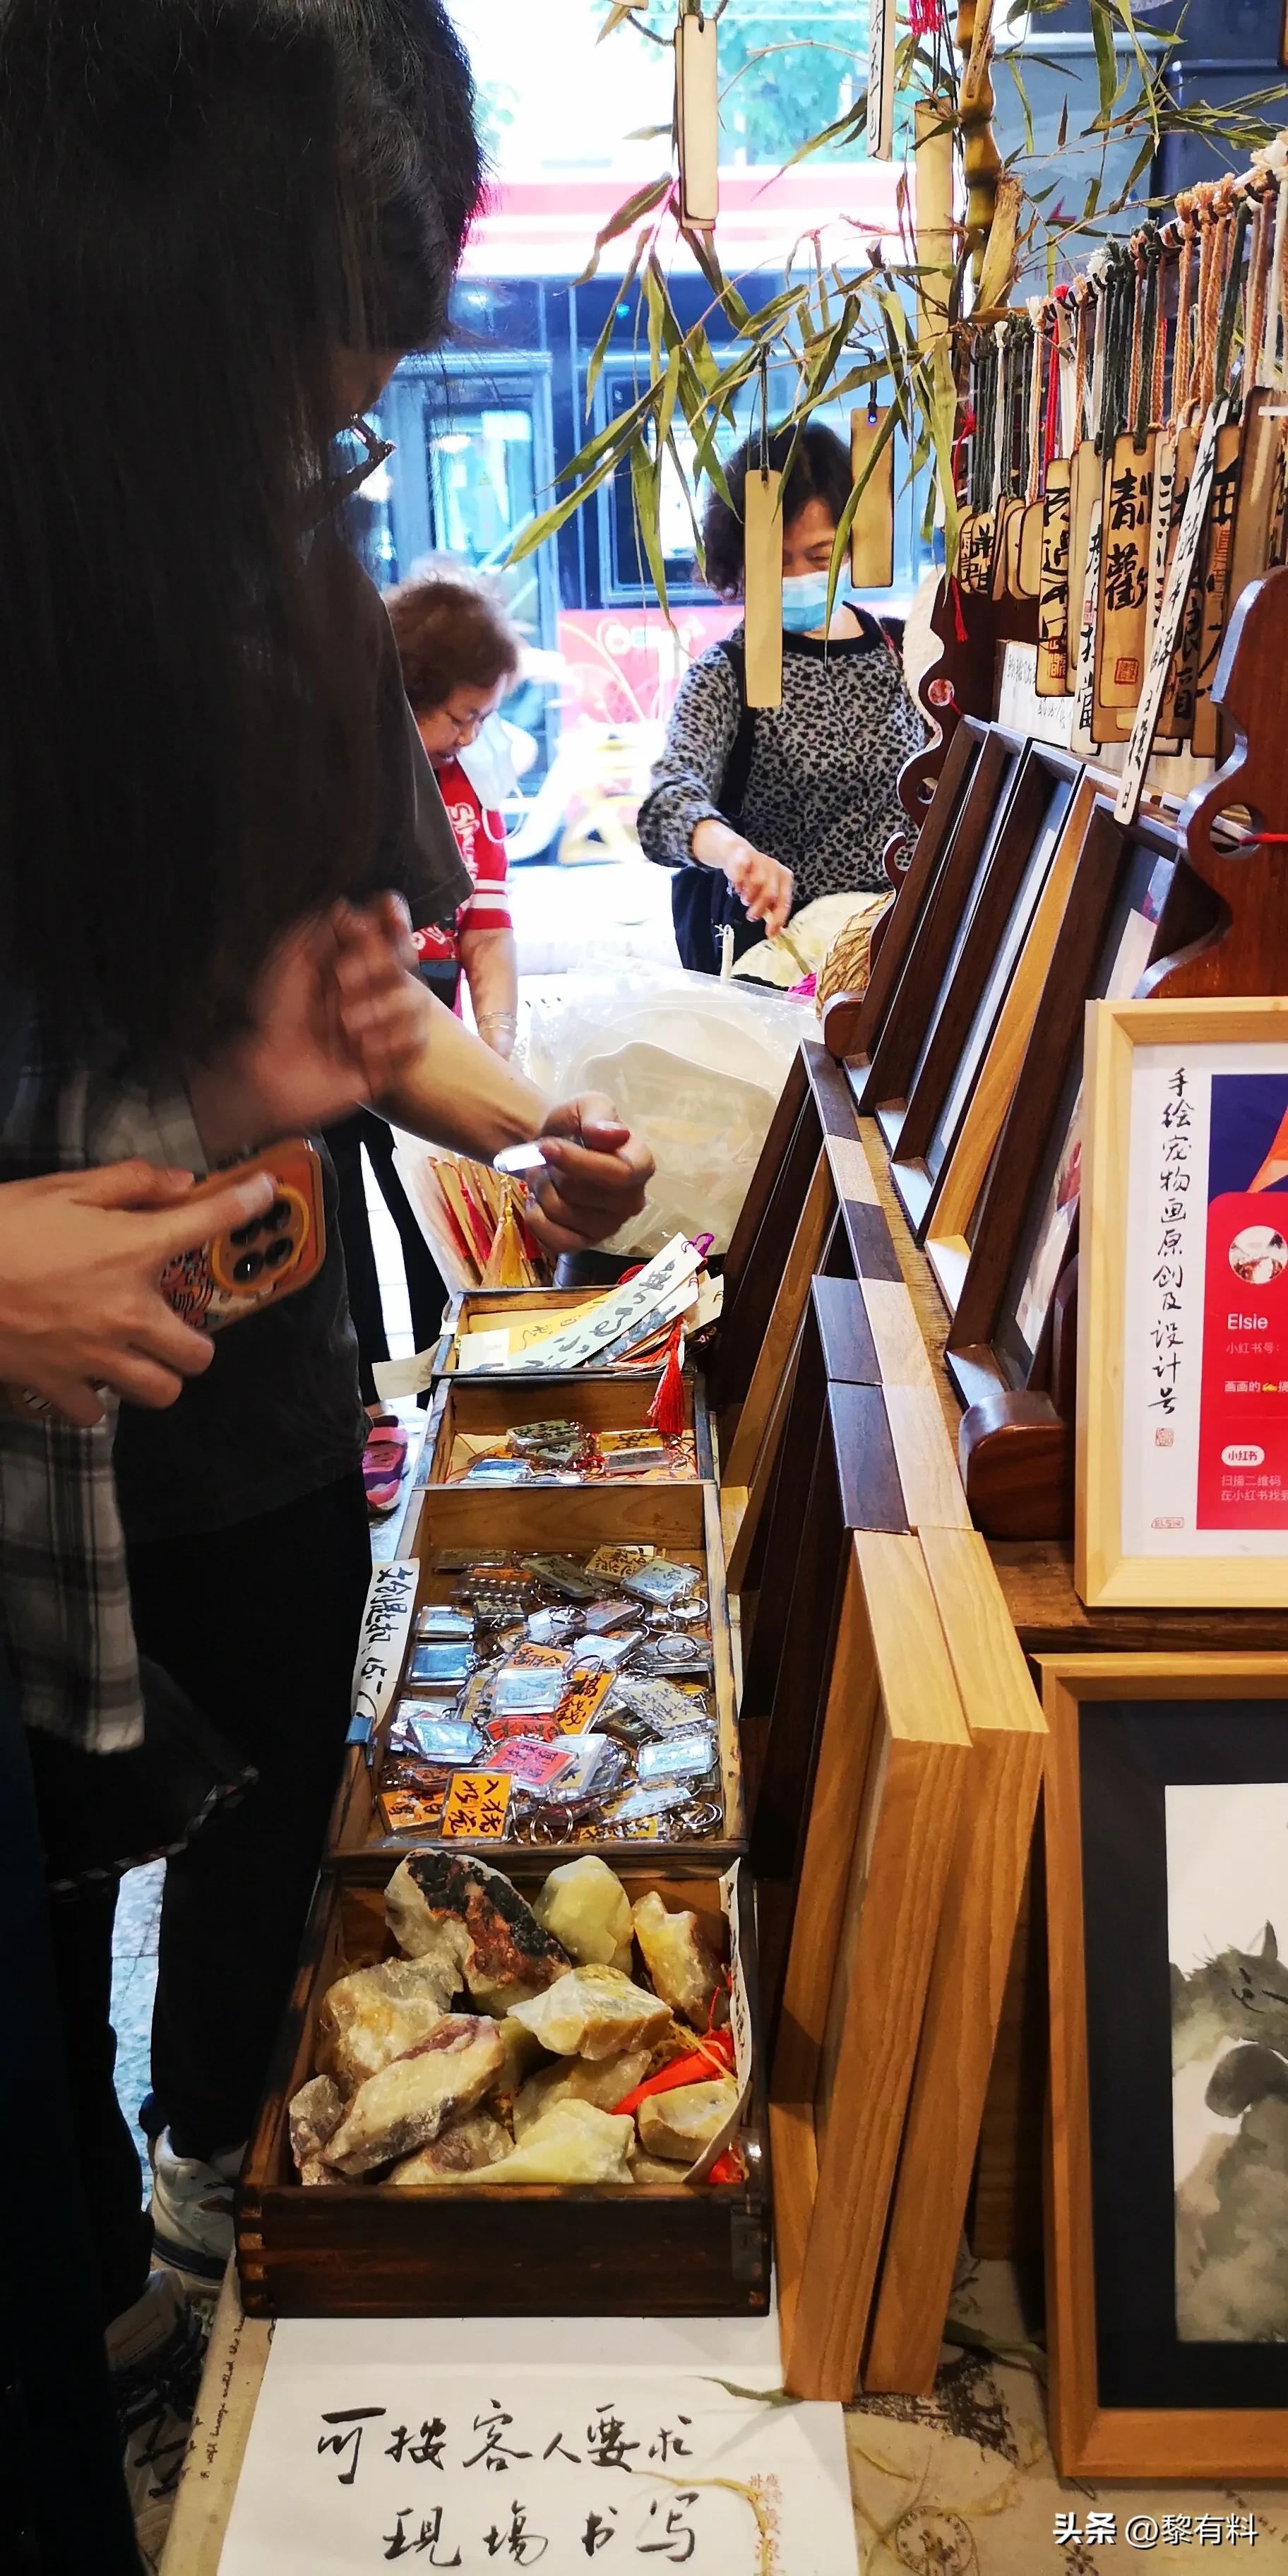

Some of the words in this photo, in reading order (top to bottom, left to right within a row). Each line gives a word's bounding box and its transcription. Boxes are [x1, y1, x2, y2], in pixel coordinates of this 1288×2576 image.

[1227, 1313, 1268, 1330] Elsie
[1227, 1450, 1258, 1461] 小红书
[1221, 1474, 1281, 1487] 扫描二维码
[317, 2399, 693, 2485] 可按客人要求
